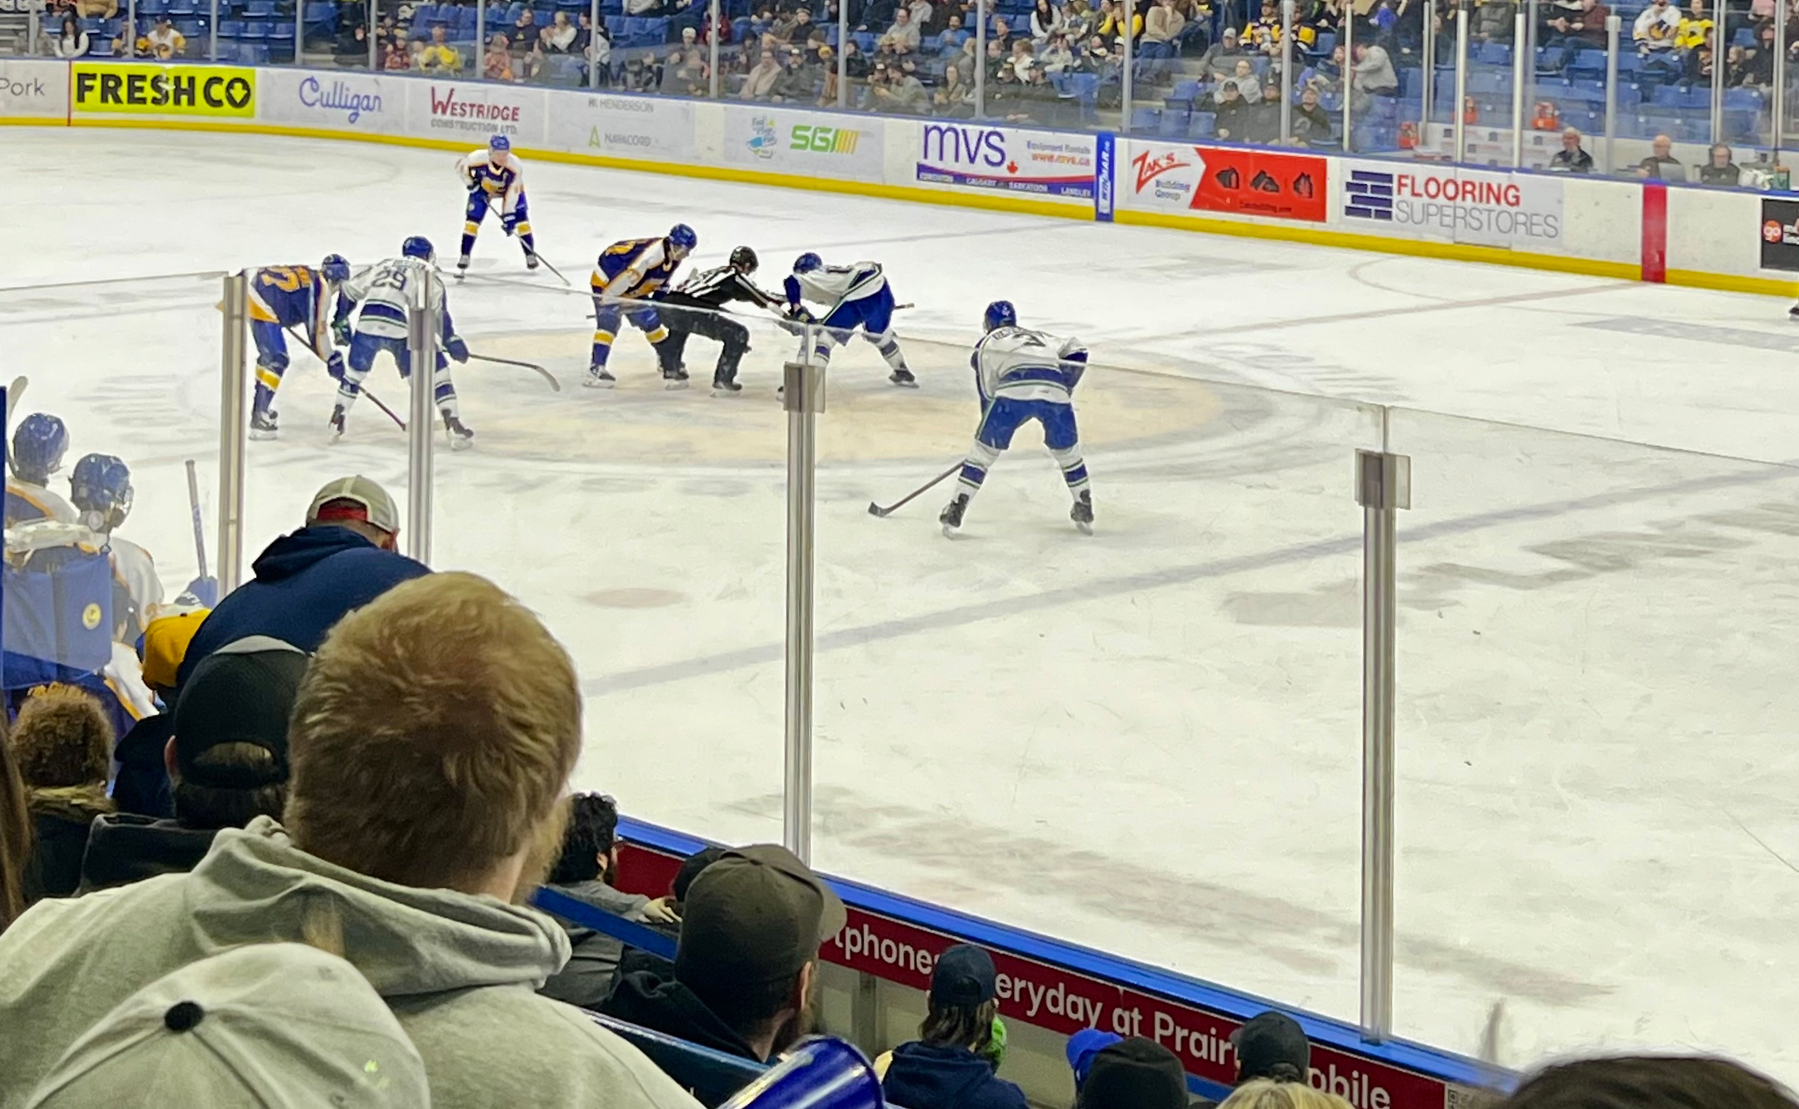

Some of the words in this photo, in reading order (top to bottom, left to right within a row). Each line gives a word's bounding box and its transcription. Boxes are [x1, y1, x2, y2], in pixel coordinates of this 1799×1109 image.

[0, 78, 45, 98] Pork
[299, 75, 382, 124] Culligan
[431, 85, 520, 122] WESTRIDGE
[600, 98, 655, 113] HENDERSON
[431, 117, 498, 134] CONSTRUCTION
[790, 124, 840, 153] SGI
[1396, 174, 1521, 208] FLOORING
[1395, 199, 1559, 239] SUPERSTORES
[834, 923, 940, 975] tphone
[994, 972, 1103, 1030] eryday
[1112, 1007, 1144, 1038] at
[1153, 1011, 1238, 1066] Prair
[1307, 1064, 1391, 1109] obile
